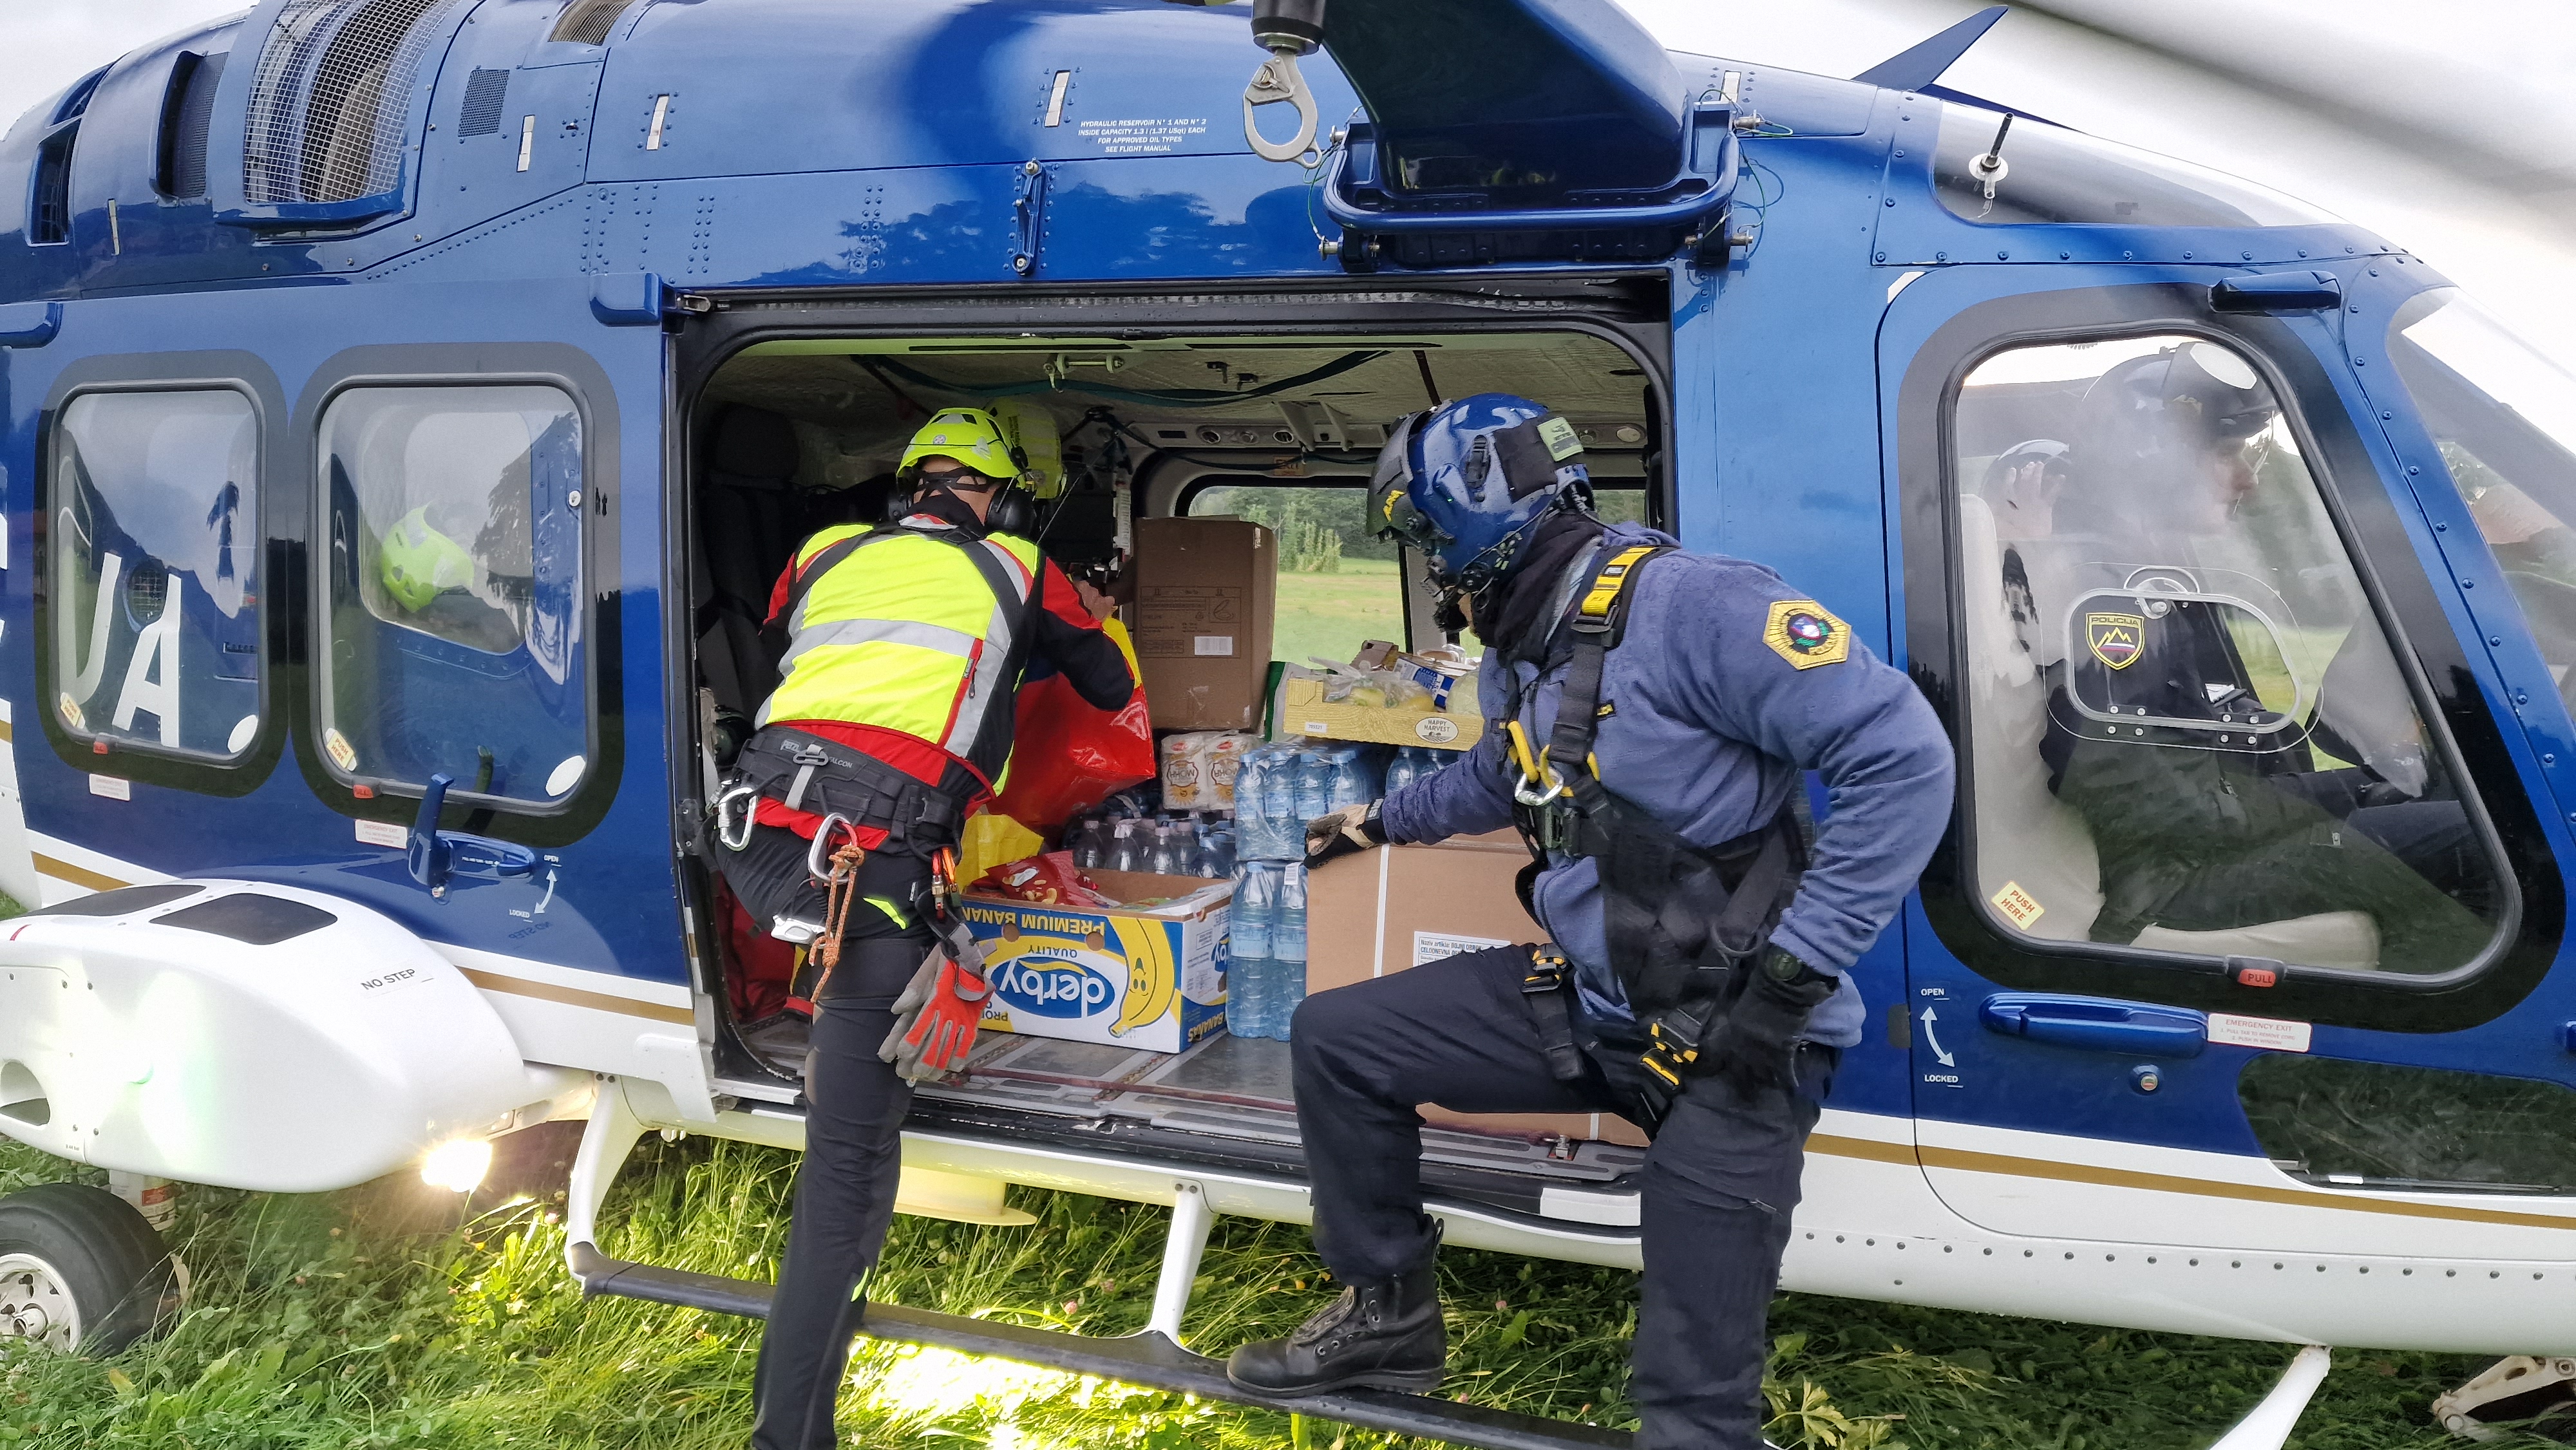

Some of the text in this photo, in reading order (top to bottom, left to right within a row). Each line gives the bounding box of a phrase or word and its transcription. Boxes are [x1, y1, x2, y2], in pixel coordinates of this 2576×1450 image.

[2091, 617, 2139, 626] POLICIJA
[331, 745, 345, 761] HERE
[335, 738, 349, 755] PUSH
[544, 854, 559, 863] OPEN
[2009, 889, 2035, 916] PUSH
[509, 909, 530, 918] LOCKED
[2000, 898, 2026, 923] HERE
[961, 905, 1105, 936] PREMIUM BANAN
[1027, 945, 1077, 958] QUALITY
[360, 968, 415, 990] NO STEP
[2248, 974, 2272, 984] PULL
[999, 957, 1106, 1018] derby
[1920, 987, 1945, 997] OPEN
[2226, 1019, 2273, 1030] EMERGENCY
[1924, 1074, 1958, 1084] LOCKED
